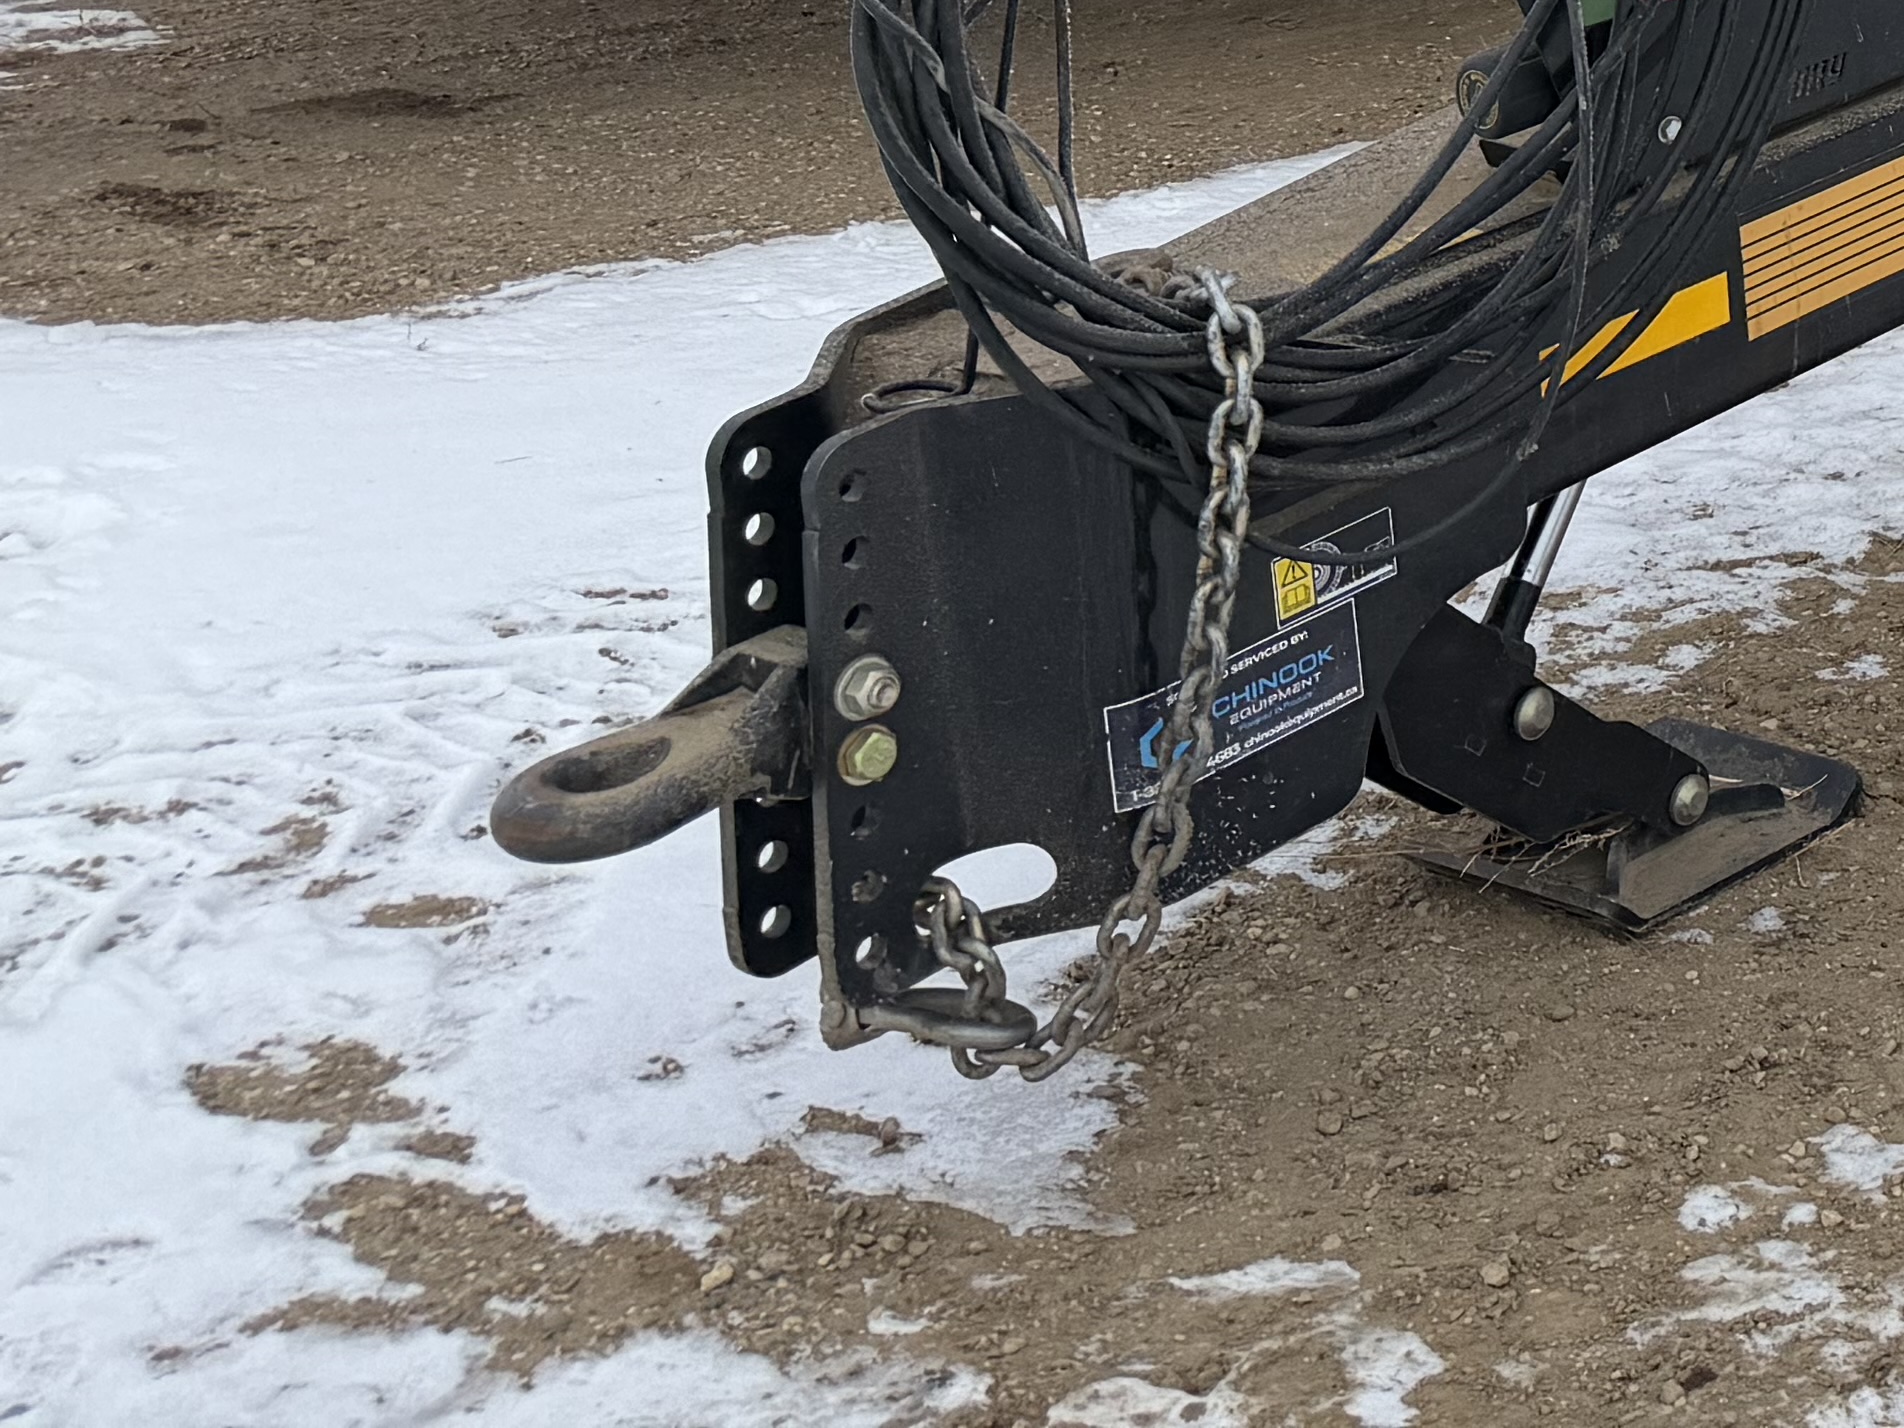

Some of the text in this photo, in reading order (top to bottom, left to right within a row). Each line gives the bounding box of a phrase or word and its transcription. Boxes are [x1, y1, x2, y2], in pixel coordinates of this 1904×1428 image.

[1211, 644, 1335, 720] CHINOOK
[1230, 640, 1289, 675] SERVICED
[1229, 671, 1322, 726] EQUIPMENT
